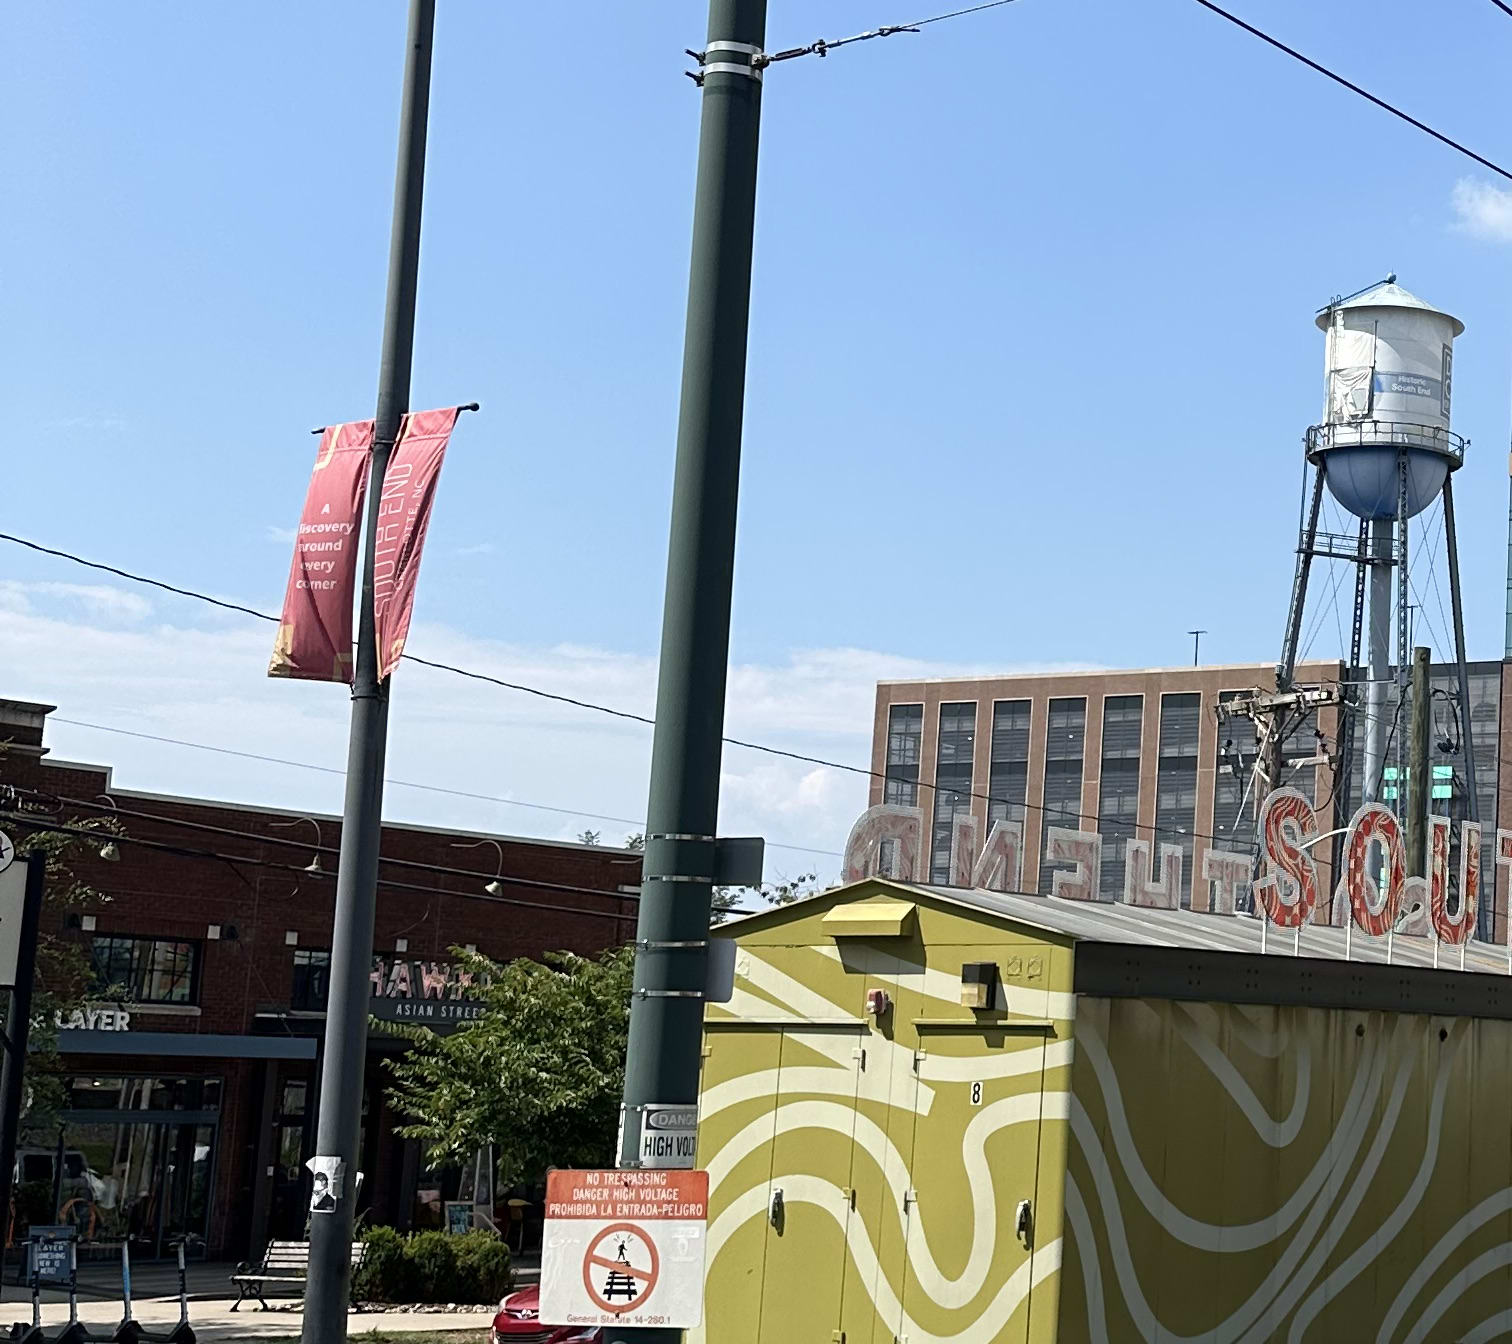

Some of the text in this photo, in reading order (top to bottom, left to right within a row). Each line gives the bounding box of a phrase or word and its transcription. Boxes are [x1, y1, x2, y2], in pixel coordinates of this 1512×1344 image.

[1398, 376, 1426, 386] Historic
[1392, 384, 1431, 395] South End
[321, 504, 330, 514] A
[374, 462, 413, 618] SOUTH END
[396, 1004, 486, 1019] ASIAN STREE
[54, 1009, 130, 1032] LAYER
[972, 1082, 981, 1104] 8
[644, 1136, 673, 1157] HIGH
[586, 1172, 667, 1186] NO TRESPASSING
[573, 1188, 679, 1201] DANGER HIGH VOLTAGE
[549, 1203, 703, 1217] PROHIBIDA LA ENTRADA-PELIGRO
[567, 1313, 599, 1323] General
